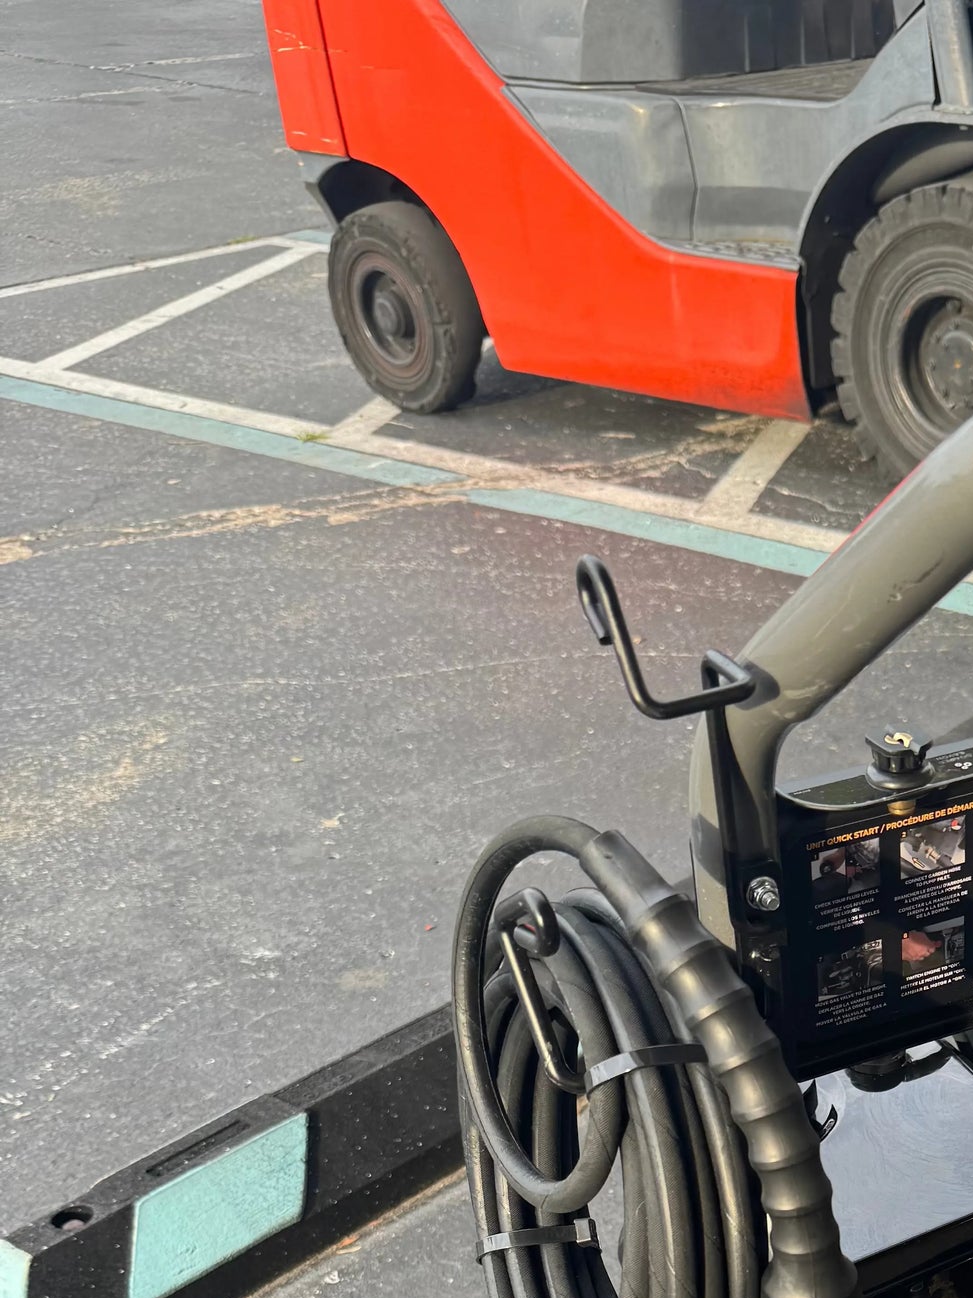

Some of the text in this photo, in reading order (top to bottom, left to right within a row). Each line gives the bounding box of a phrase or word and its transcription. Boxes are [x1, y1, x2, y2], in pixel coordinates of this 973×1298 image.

[806, 840, 825, 850] UNIT
[826, 833, 852, 845] QUICK
[853, 826, 879, 838] START
[886, 813, 933, 830] PROCÉDURE
[904, 874, 927, 885] CONNECT
[927, 869, 947, 879] GARDEN
[894, 890, 919, 901] BRANCHER
[814, 900, 831, 909] CHECK
[832, 897, 845, 905] YOUR
[898, 902, 924, 913] CONECTAR
[932, 892, 960, 904] MANGUERA
[937, 897, 960, 907] ENTRADA
[858, 909, 880, 918] NIVELES
